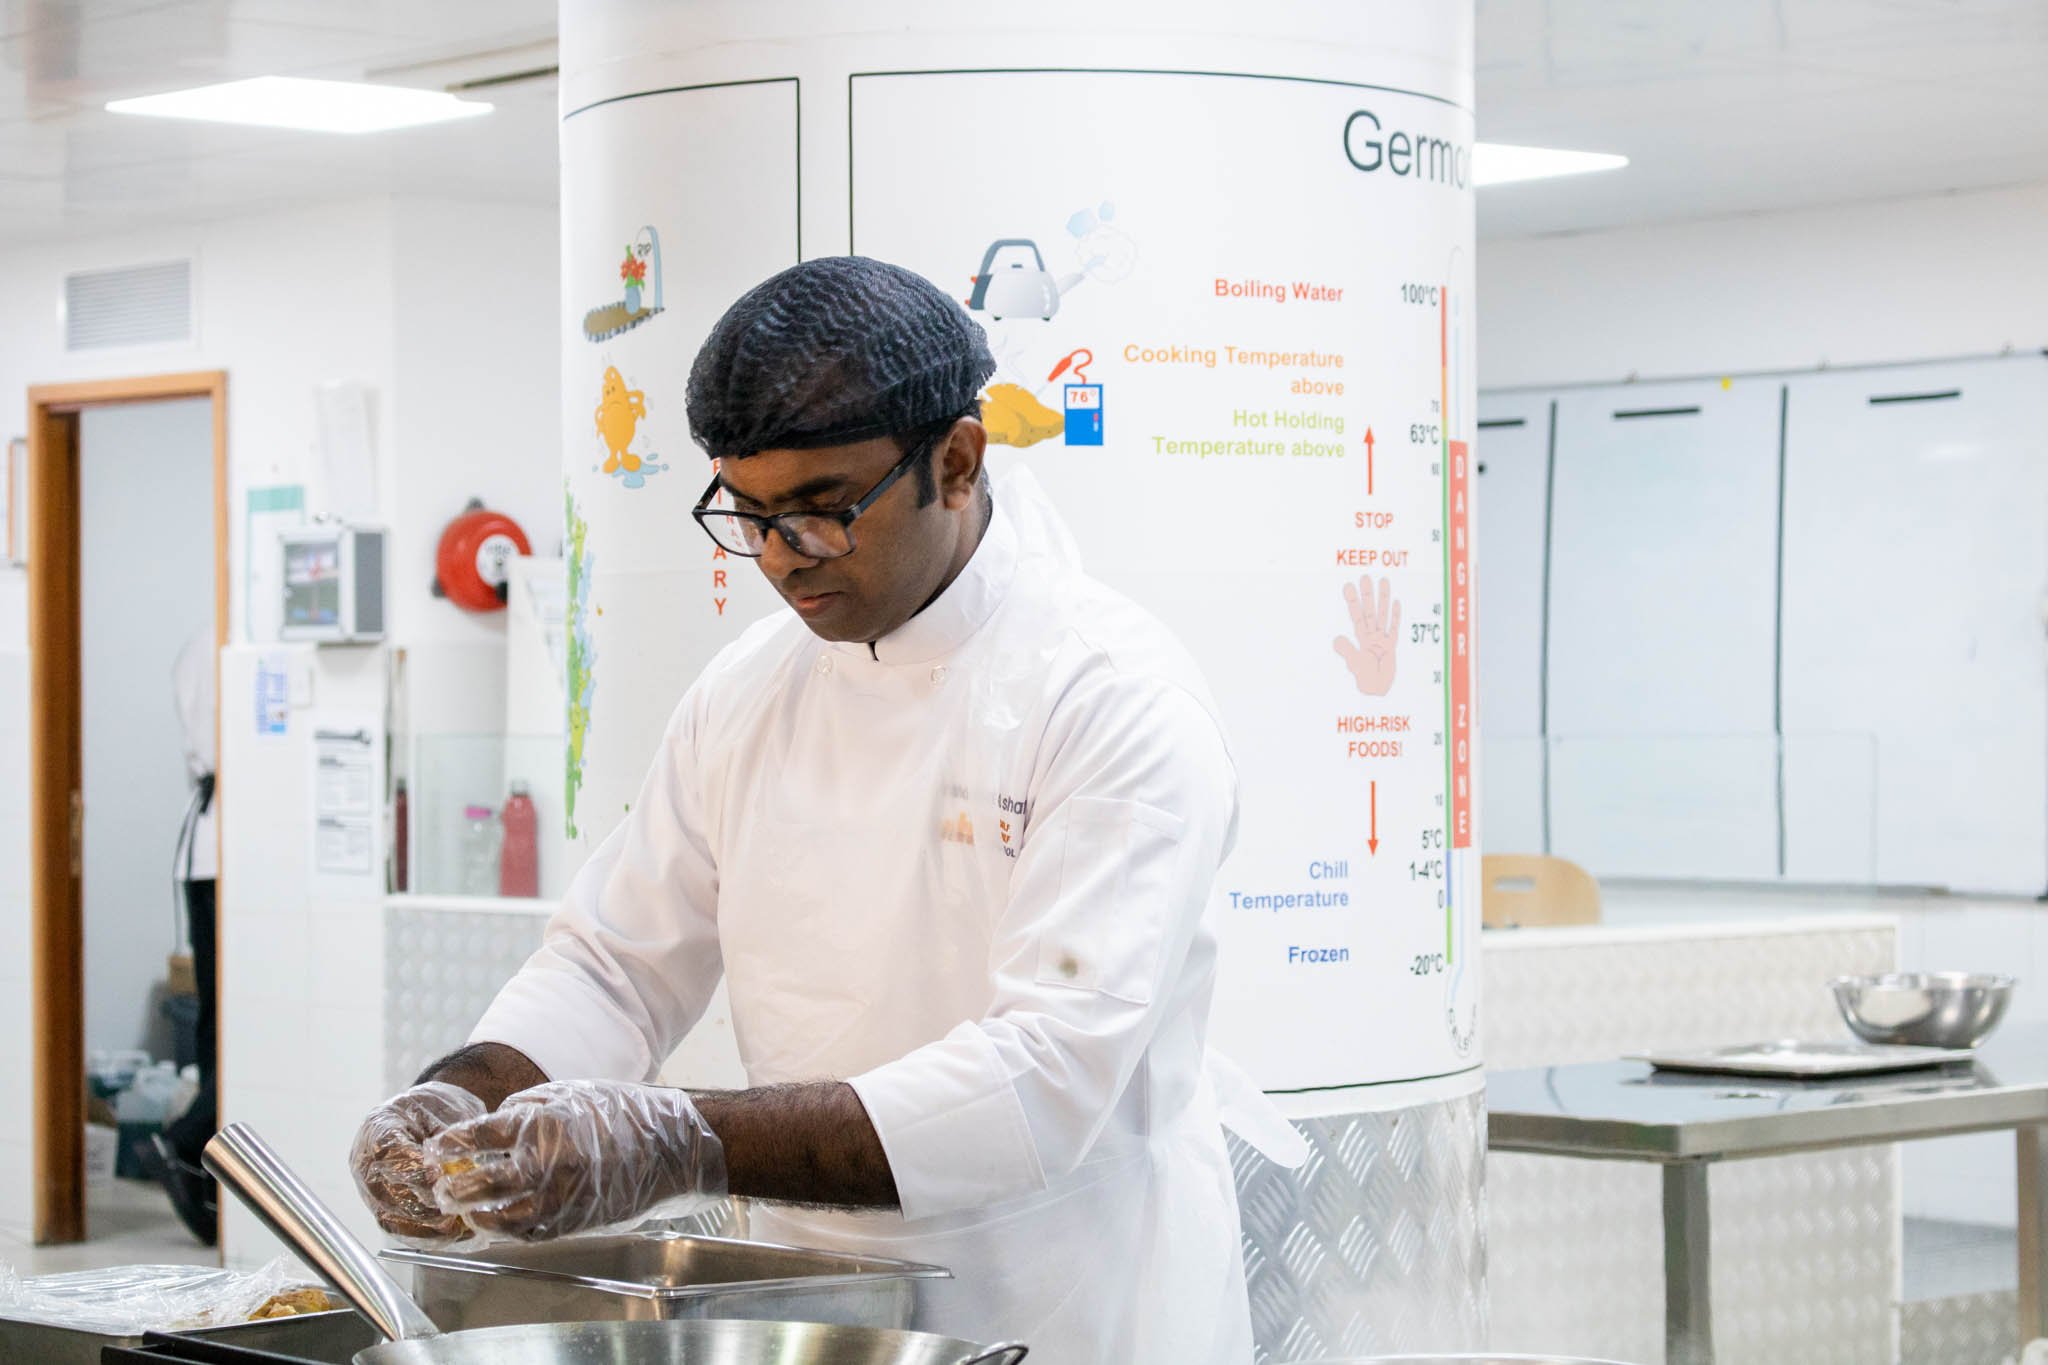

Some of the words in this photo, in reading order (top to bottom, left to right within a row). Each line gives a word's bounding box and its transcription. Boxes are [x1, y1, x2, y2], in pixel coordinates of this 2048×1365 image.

[1343, 110, 1466, 190] Germo
[1215, 278, 1286, 303] Boiling
[1293, 283, 1343, 301] Water
[1401, 283, 1437, 307] 100°C
[1124, 344, 1216, 368] Cooking
[1225, 346, 1343, 369] Temperature
[1291, 378, 1344, 396] above
[1233, 409, 1267, 428] Hot
[1274, 411, 1344, 435] Holding
[1410, 424, 1438, 445] 63°C
[1152, 437, 1285, 459] Temperature
[1292, 439, 1344, 457] above
[1355, 512, 1393, 528] STOP
[1337, 549, 1377, 565] KEEP
[1381, 550, 1408, 567] OUT
[1455, 456, 1466, 656] DANGER
[1412, 624, 1440, 643] 37°C
[1337, 716, 1410, 733] HIGH-RISK
[1349, 741, 1402, 757] FOODS!
[1457, 703, 1467, 835] ZONE
[1422, 829, 1441, 849] 5°C
[1309, 861, 1348, 880] Chill
[1410, 860, 1442, 880] 1-4°C
[1229, 891, 1348, 912] Temperature
[1289, 946, 1349, 963] Frozen
[1410, 953, 1442, 975] -20°C
